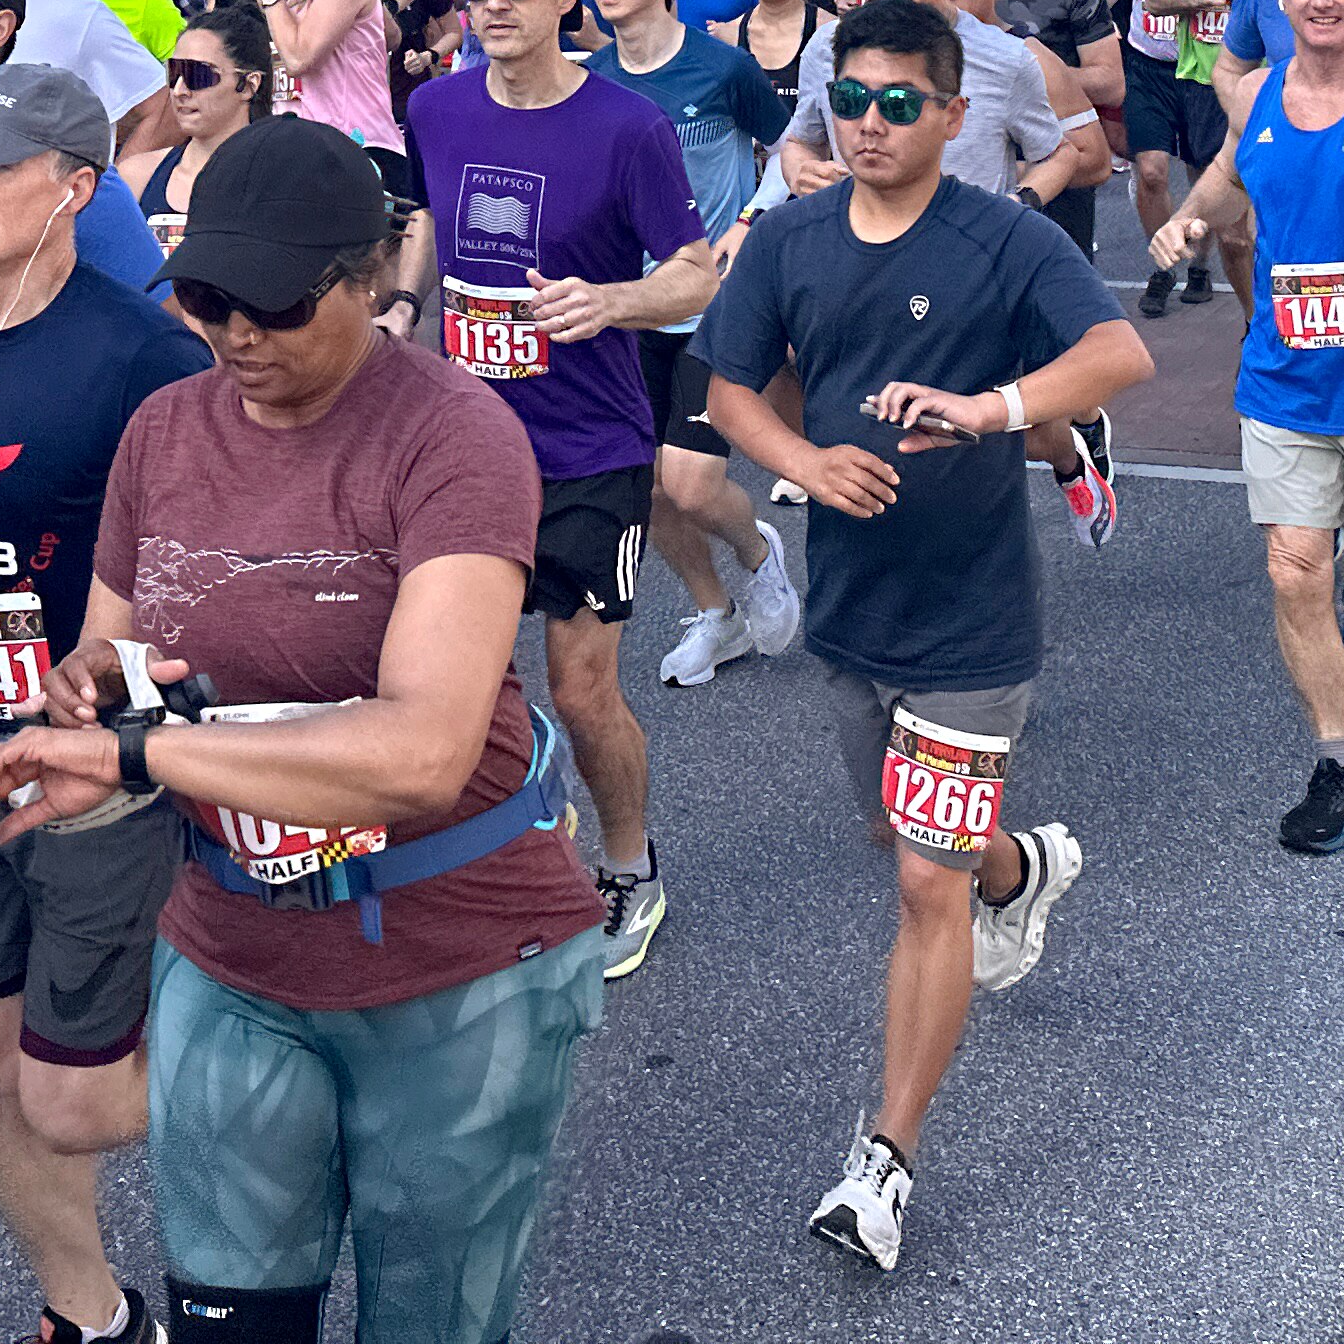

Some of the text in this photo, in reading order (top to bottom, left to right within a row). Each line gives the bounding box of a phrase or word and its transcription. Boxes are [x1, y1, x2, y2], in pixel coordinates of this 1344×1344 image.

[1148, 15, 1179, 34] 110
[472, 173, 533, 192] PATAPSCO
[458, 238, 498, 252] VALLEY
[456, 317, 539, 365] 1135
[475, 363, 508, 377] HALF
[894, 762, 996, 834] 1266
[909, 825, 951, 846] HALF
[256, 853, 315, 881] HALF
